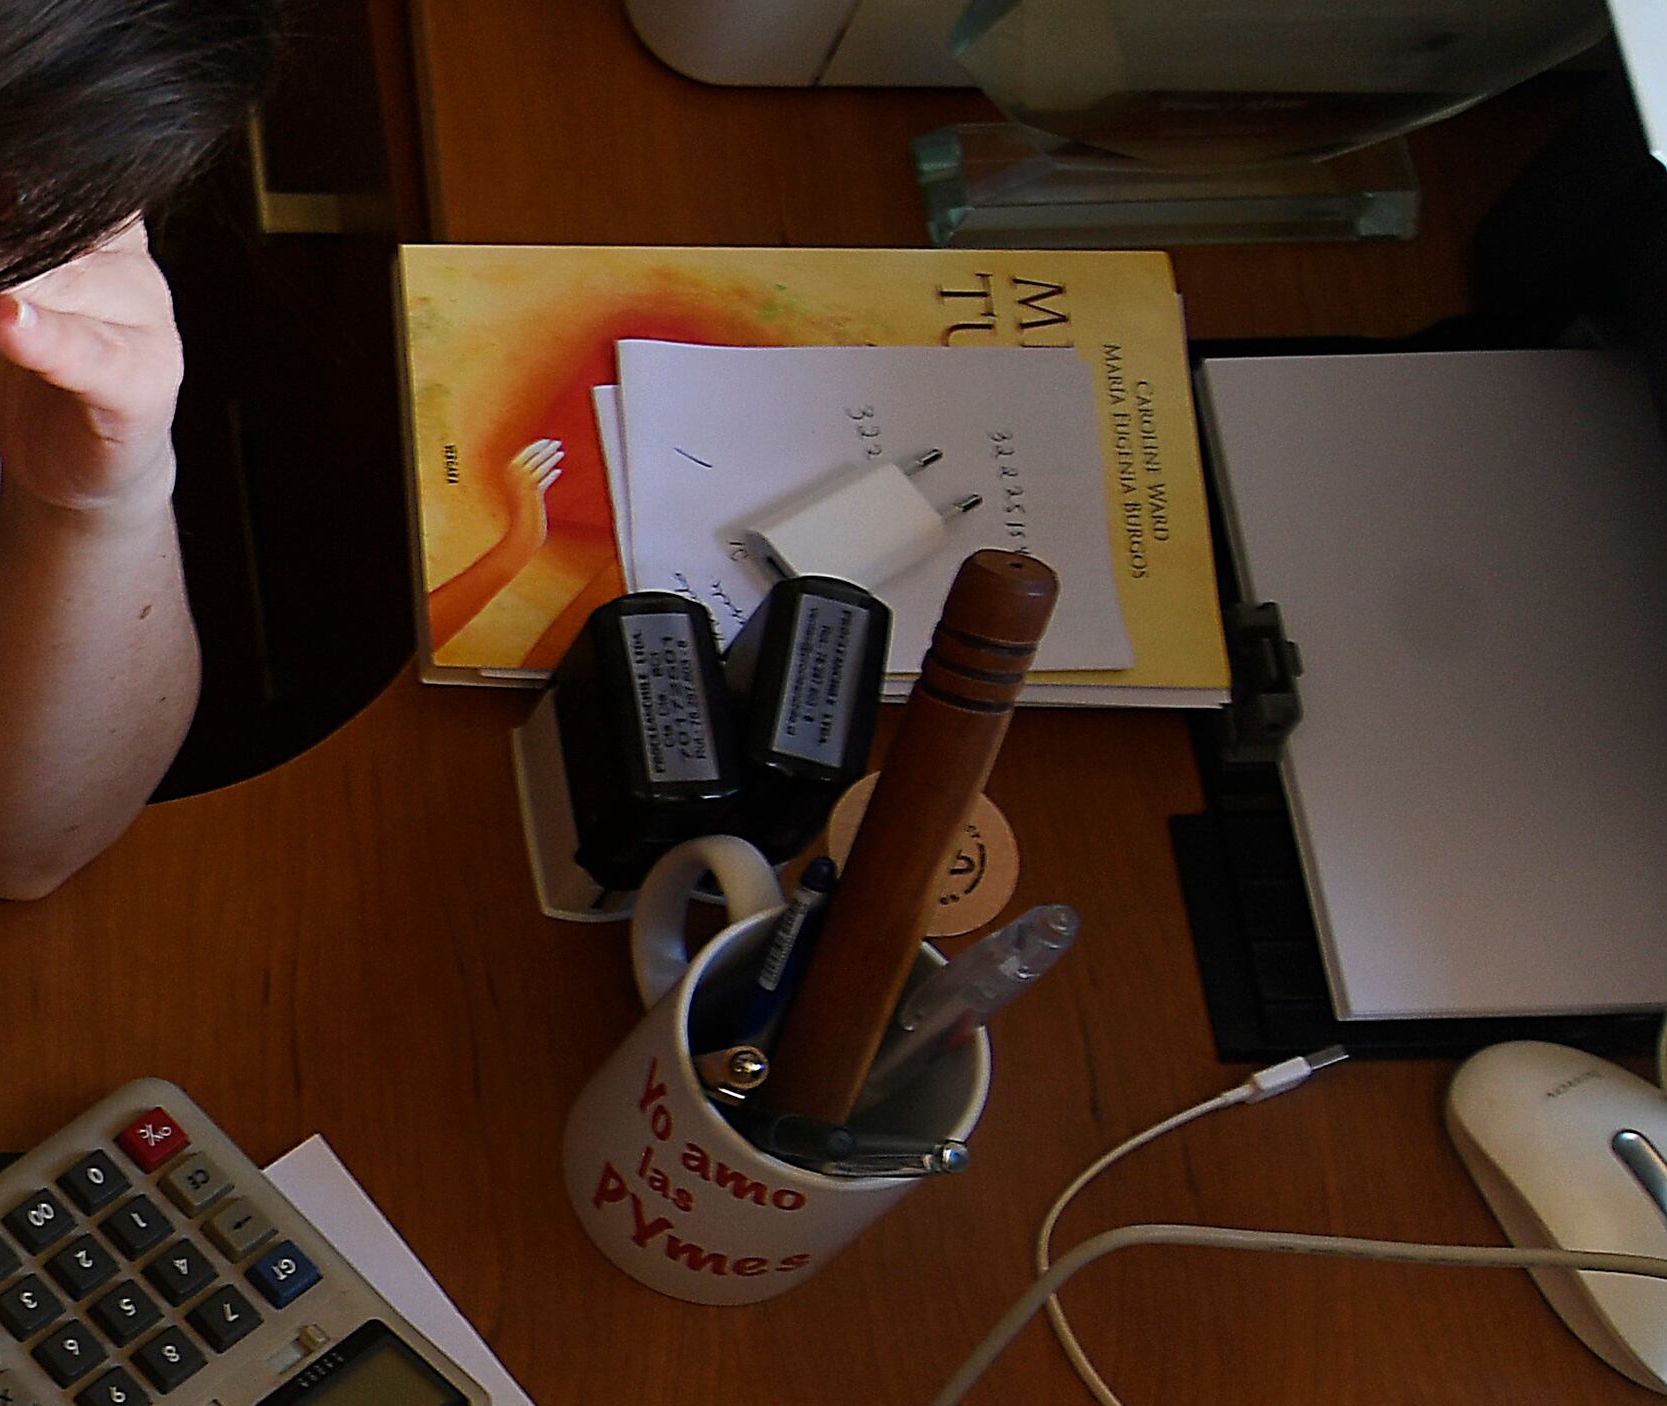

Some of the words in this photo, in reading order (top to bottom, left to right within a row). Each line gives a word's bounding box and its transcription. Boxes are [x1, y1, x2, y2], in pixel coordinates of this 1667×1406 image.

[1148, 483, 1168, 540] WARD
[1124, 503, 1146, 577] BURGOS
[87, 1168, 103, 1183] 0
[187, 1169, 209, 1189] CE
[638, 1146, 693, 1211] las
[681, 1143, 806, 1210] amo
[28, 1203, 53, 1225] 00
[131, 1213, 146, 1227] 1
[75, 1250, 92, 1267] 2
[173, 1258, 187, 1274] 4
[272, 1258, 295, 1279] GT
[21, 1292, 37, 1308] 3
[120, 1298, 135, 1315] 5
[223, 1303, 238, 1321] 7
[64, 1339, 79, 1354] 6
[163, 1345, 179, 1361] 8
[110, 1386, 125, 1402] 9
